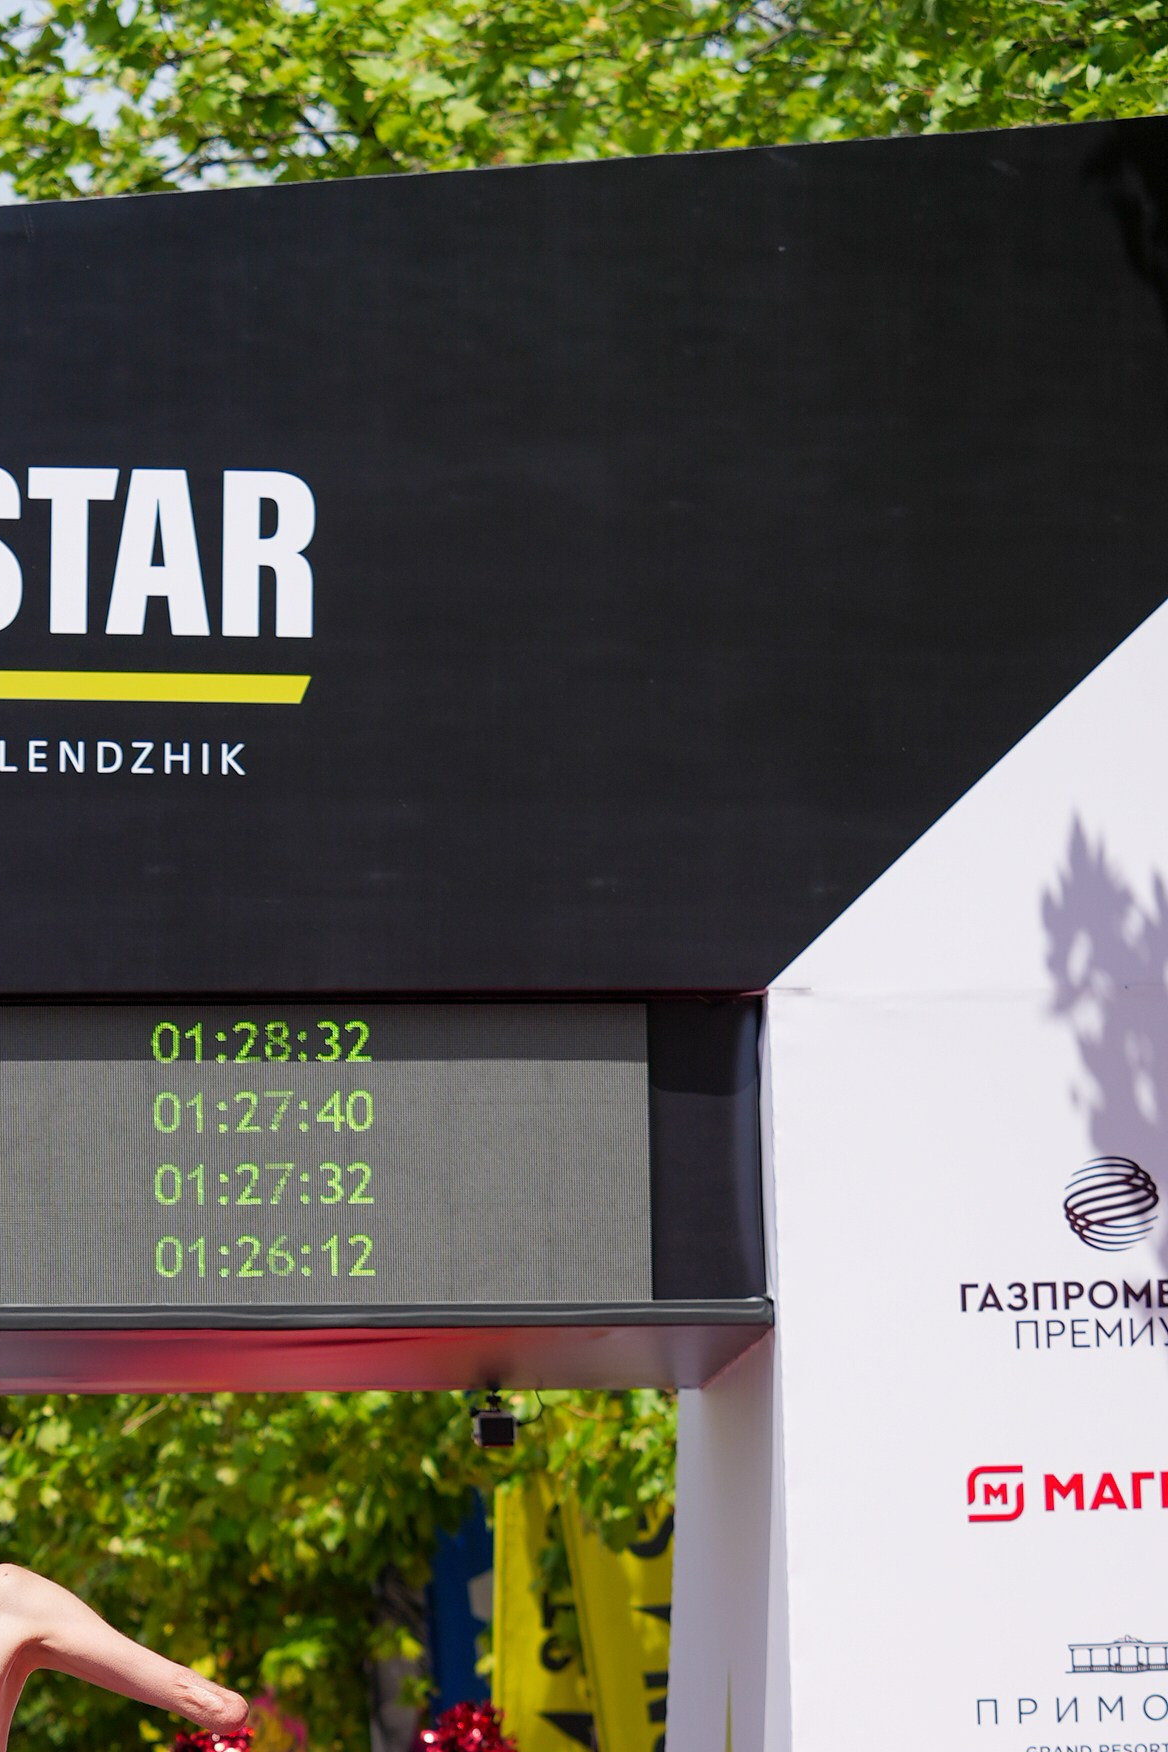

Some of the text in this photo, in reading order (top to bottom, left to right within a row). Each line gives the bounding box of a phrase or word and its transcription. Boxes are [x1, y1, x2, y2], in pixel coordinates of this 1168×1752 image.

[151, 1020, 373, 1063] 01:28:32
[153, 1089, 374, 1133] 01:27:40
[154, 1162, 375, 1205] 01:27:32
[155, 1234, 376, 1278] 01:26:12
[1043, 1471, 1168, 1512] МАГ
[976, 1694, 1168, 1724] ПРИМО
